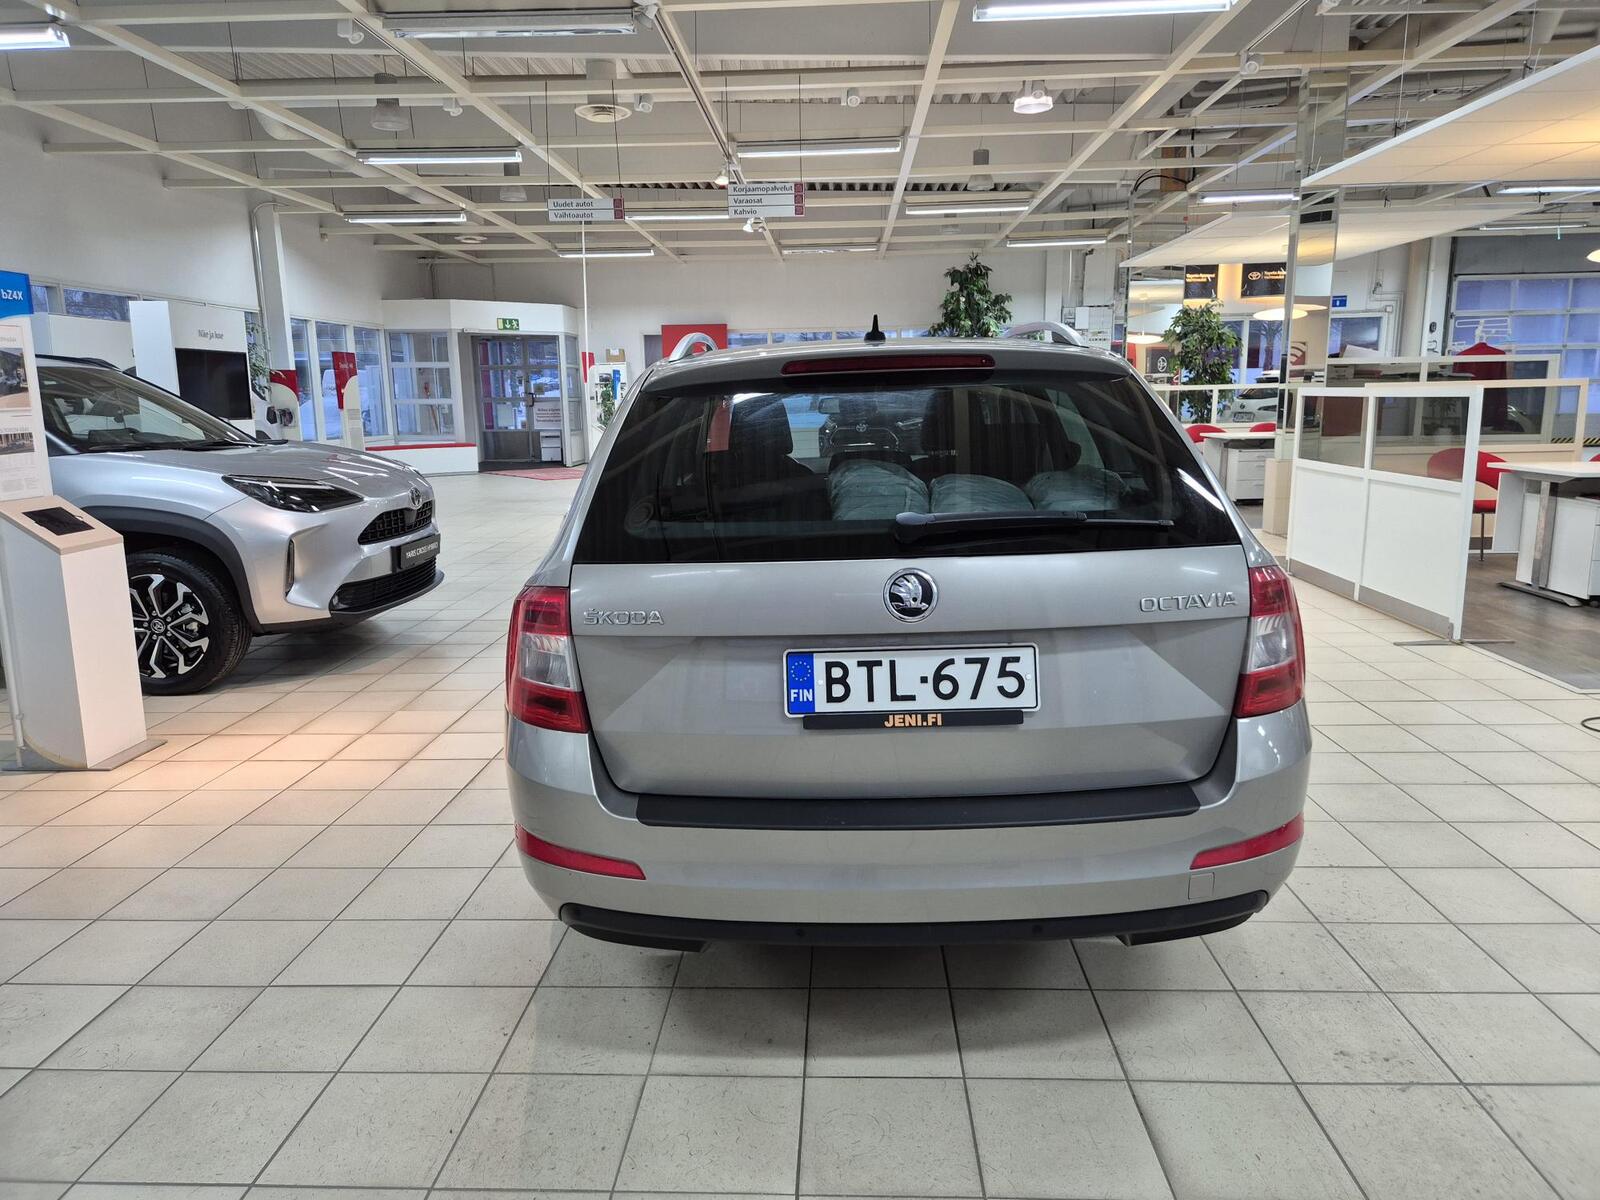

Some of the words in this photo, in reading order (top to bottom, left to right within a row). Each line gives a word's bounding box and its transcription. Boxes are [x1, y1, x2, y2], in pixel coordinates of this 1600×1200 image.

[733, 185, 793, 193] Korjaamopalvelut
[0, 289, 24, 301] bZ4X
[1140, 591, 1238, 613] OCTAVIA
[583, 607, 664, 626] ŠKODA
[790, 688, 813, 703] FIN
[824, 656, 1026, 704] BTL-675
[884, 713, 943, 728] JENI.FI
